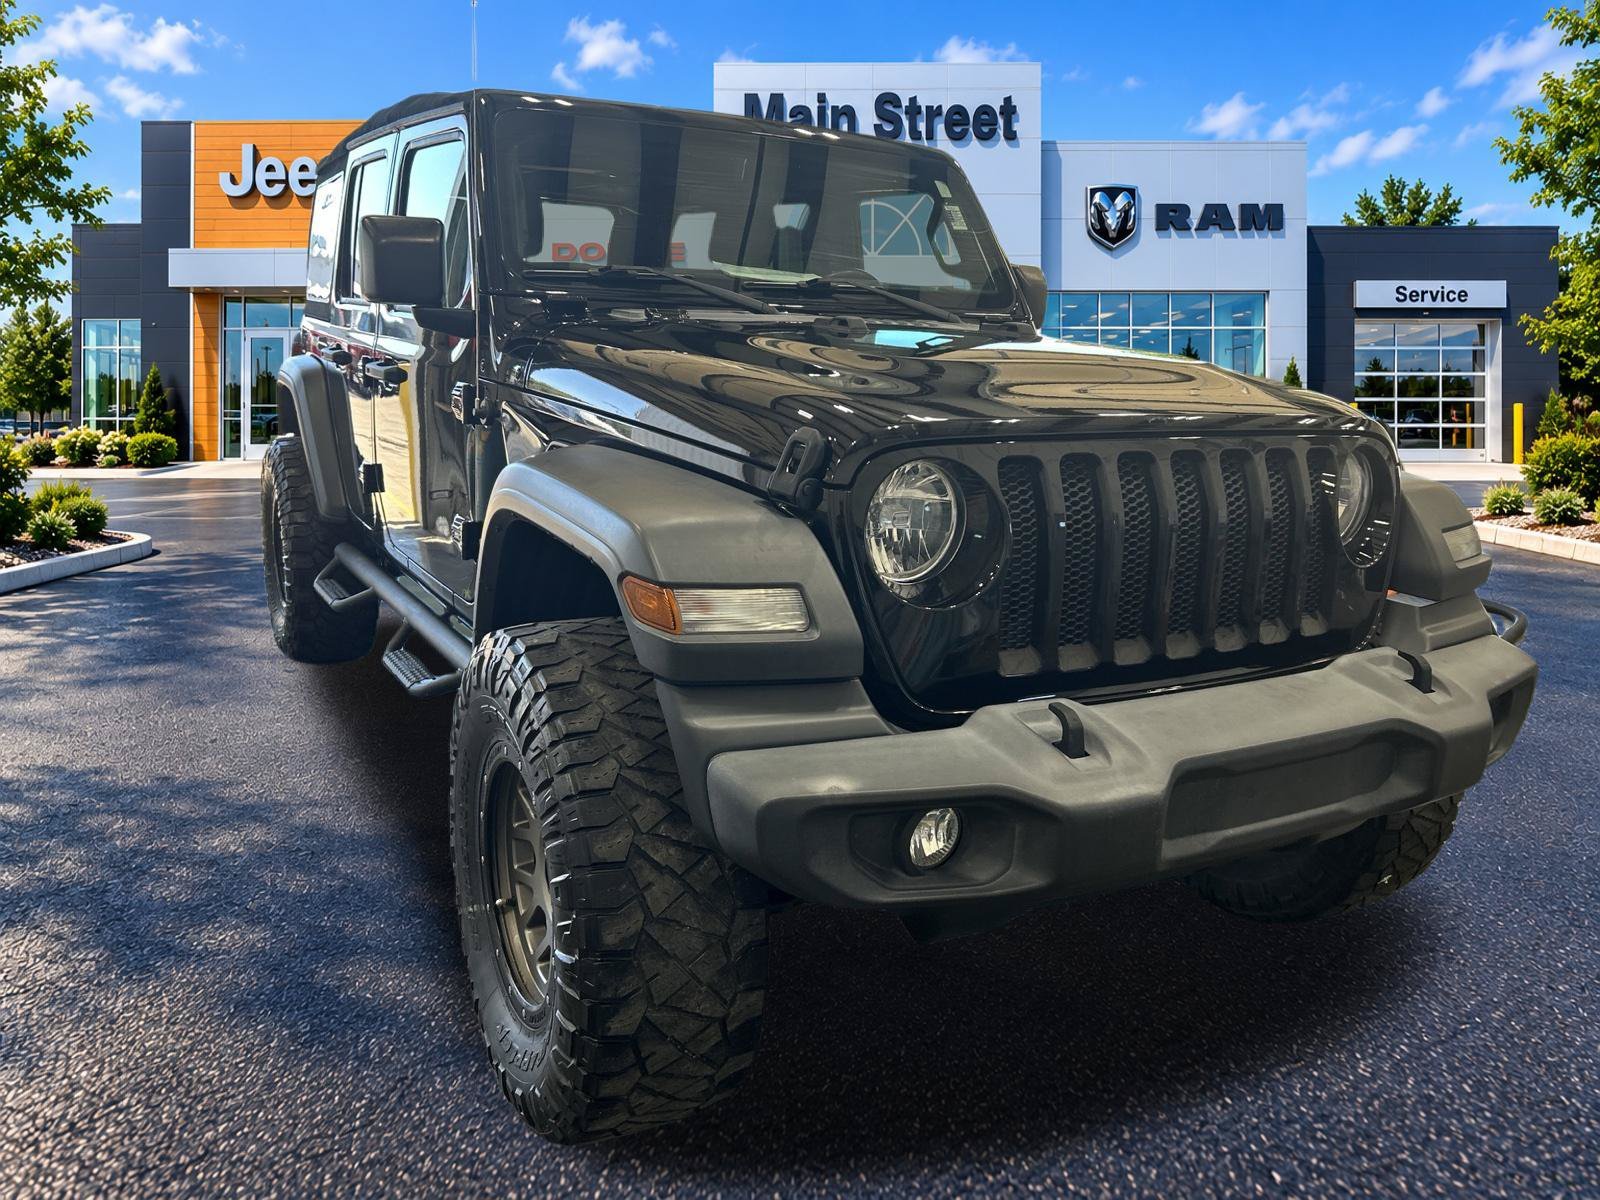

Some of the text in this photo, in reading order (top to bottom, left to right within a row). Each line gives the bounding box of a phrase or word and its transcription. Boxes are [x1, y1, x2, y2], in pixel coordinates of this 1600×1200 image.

[744, 91, 1018, 141] Main Street
[218, 143, 318, 197] Jee
[1155, 203, 1283, 231] RAM
[551, 241, 687, 262] DOE
[1395, 285, 1468, 303] Service
